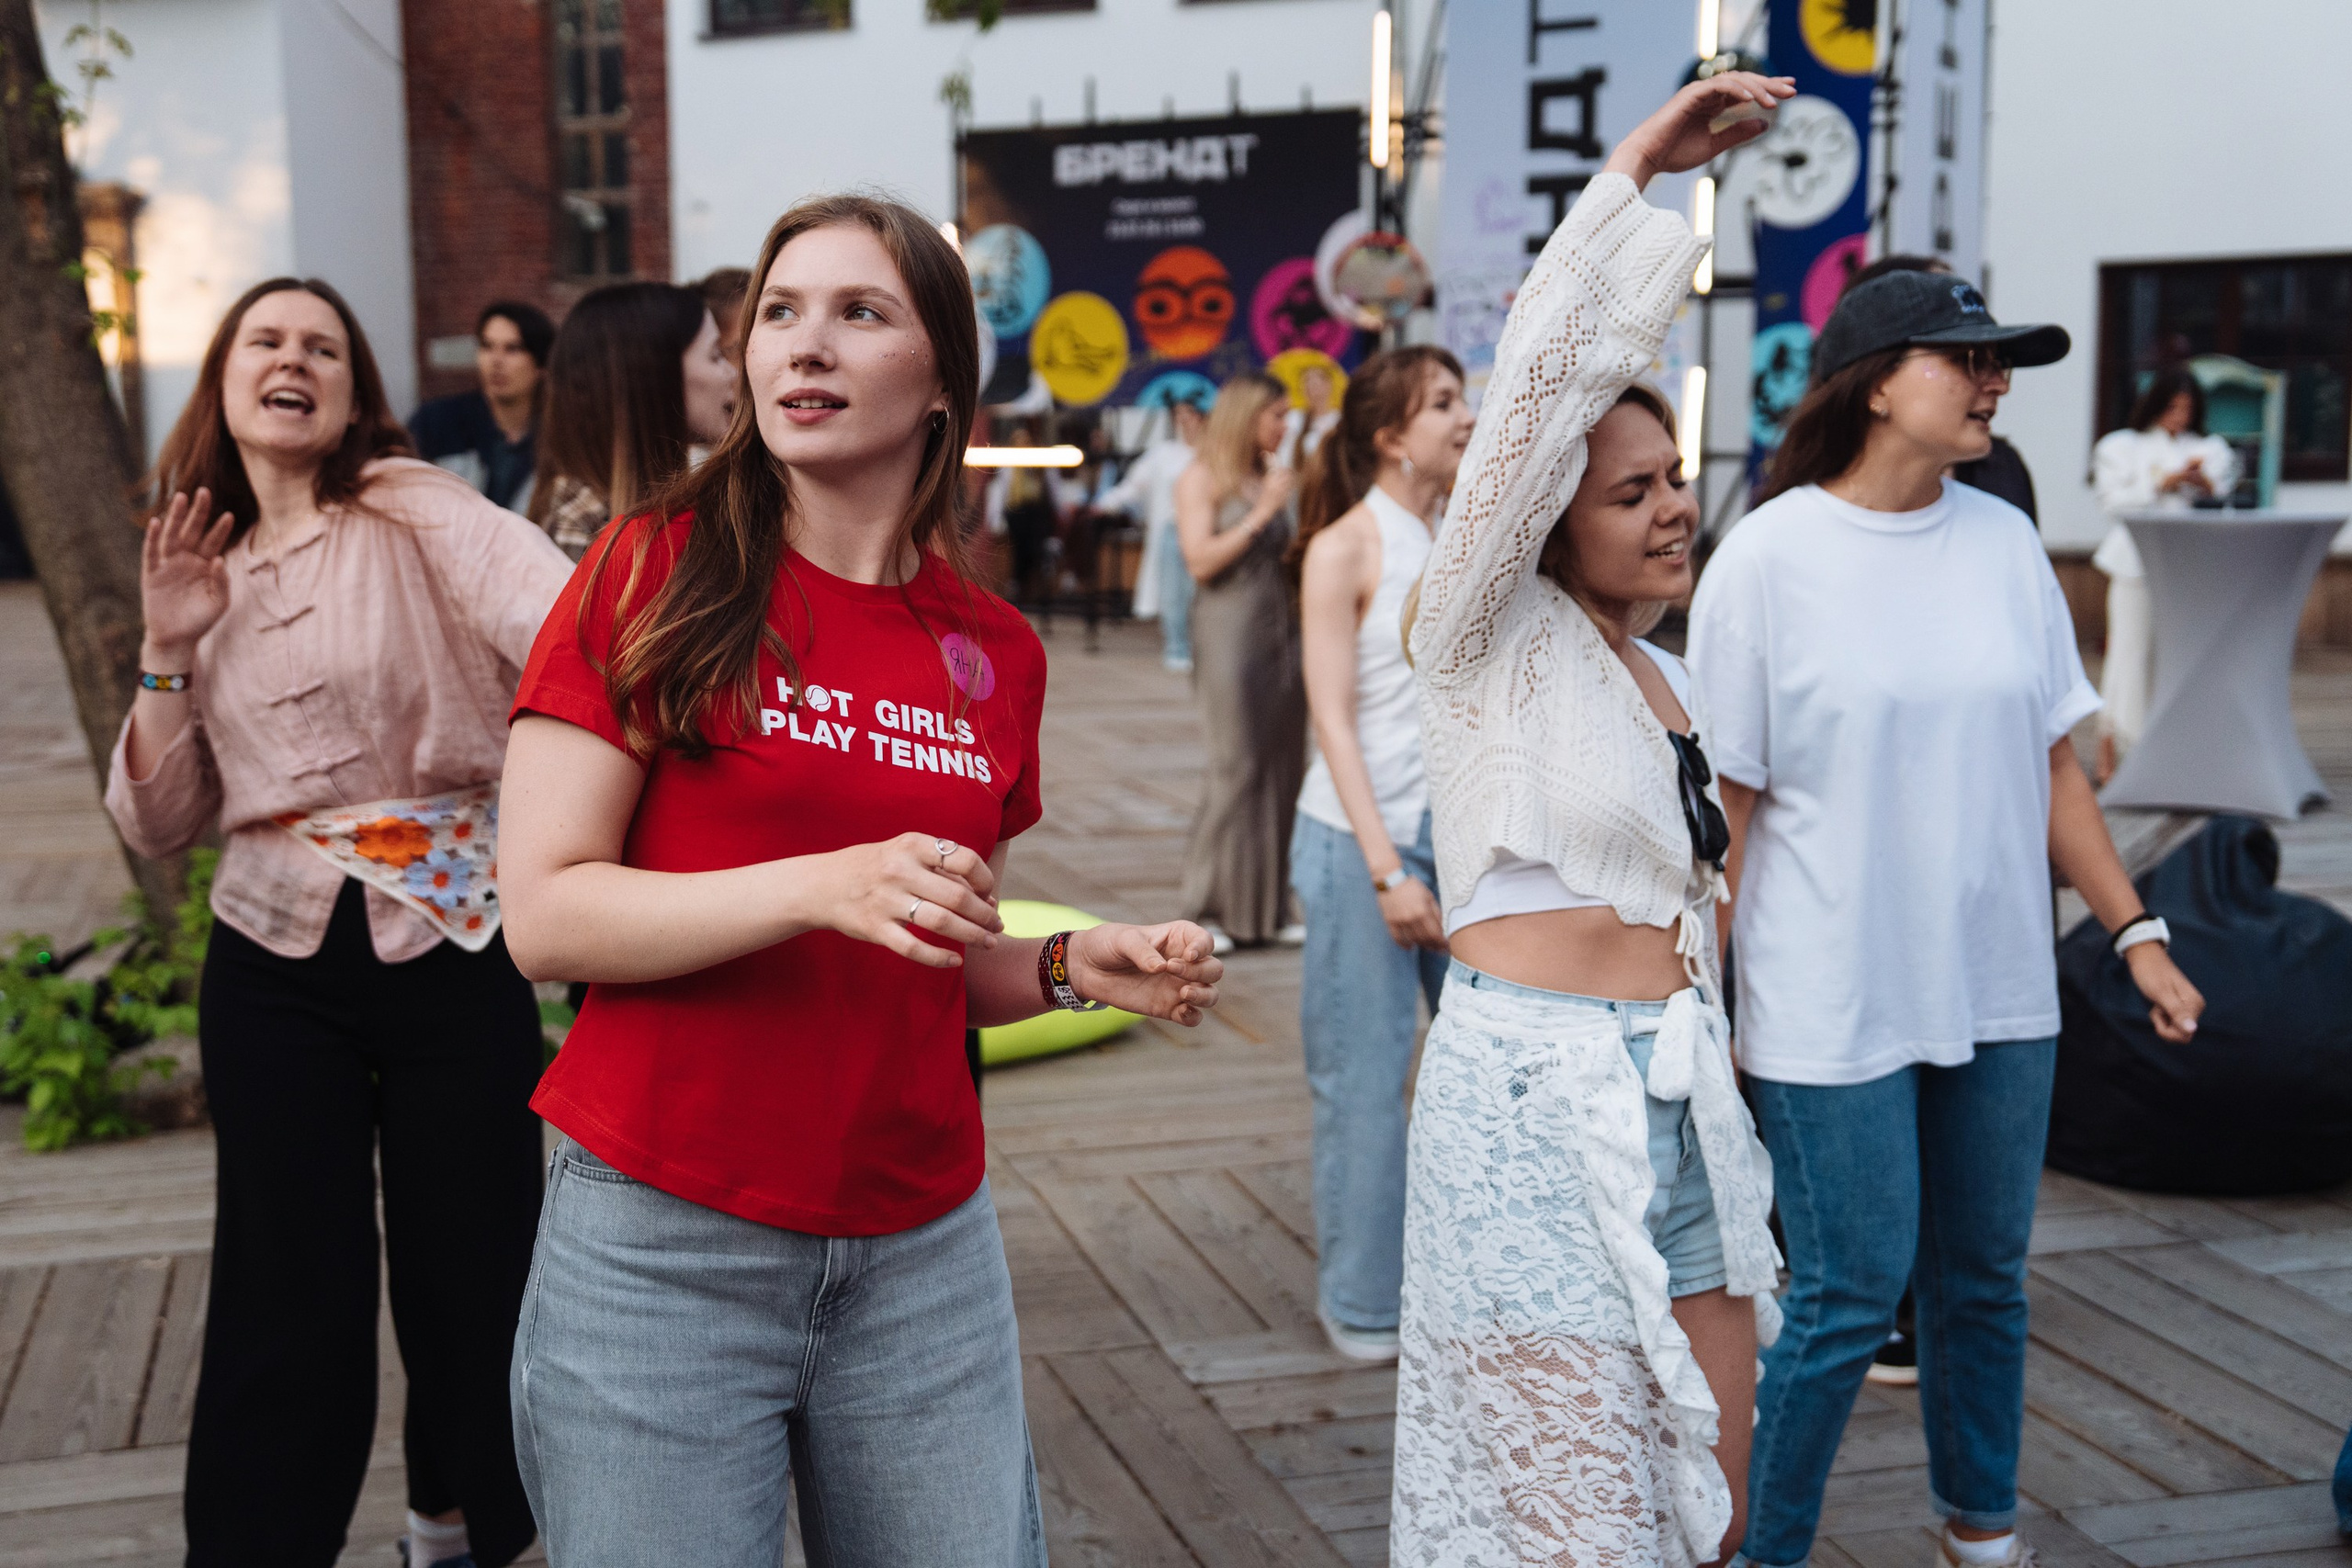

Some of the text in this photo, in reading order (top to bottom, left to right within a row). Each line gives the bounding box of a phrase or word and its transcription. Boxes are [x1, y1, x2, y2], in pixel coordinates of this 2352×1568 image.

[1526, 0, 1605, 255] НДТ
[761, 708, 992, 784] PLAY TENNIS
[776, 676, 976, 745] HOT GIRLS
